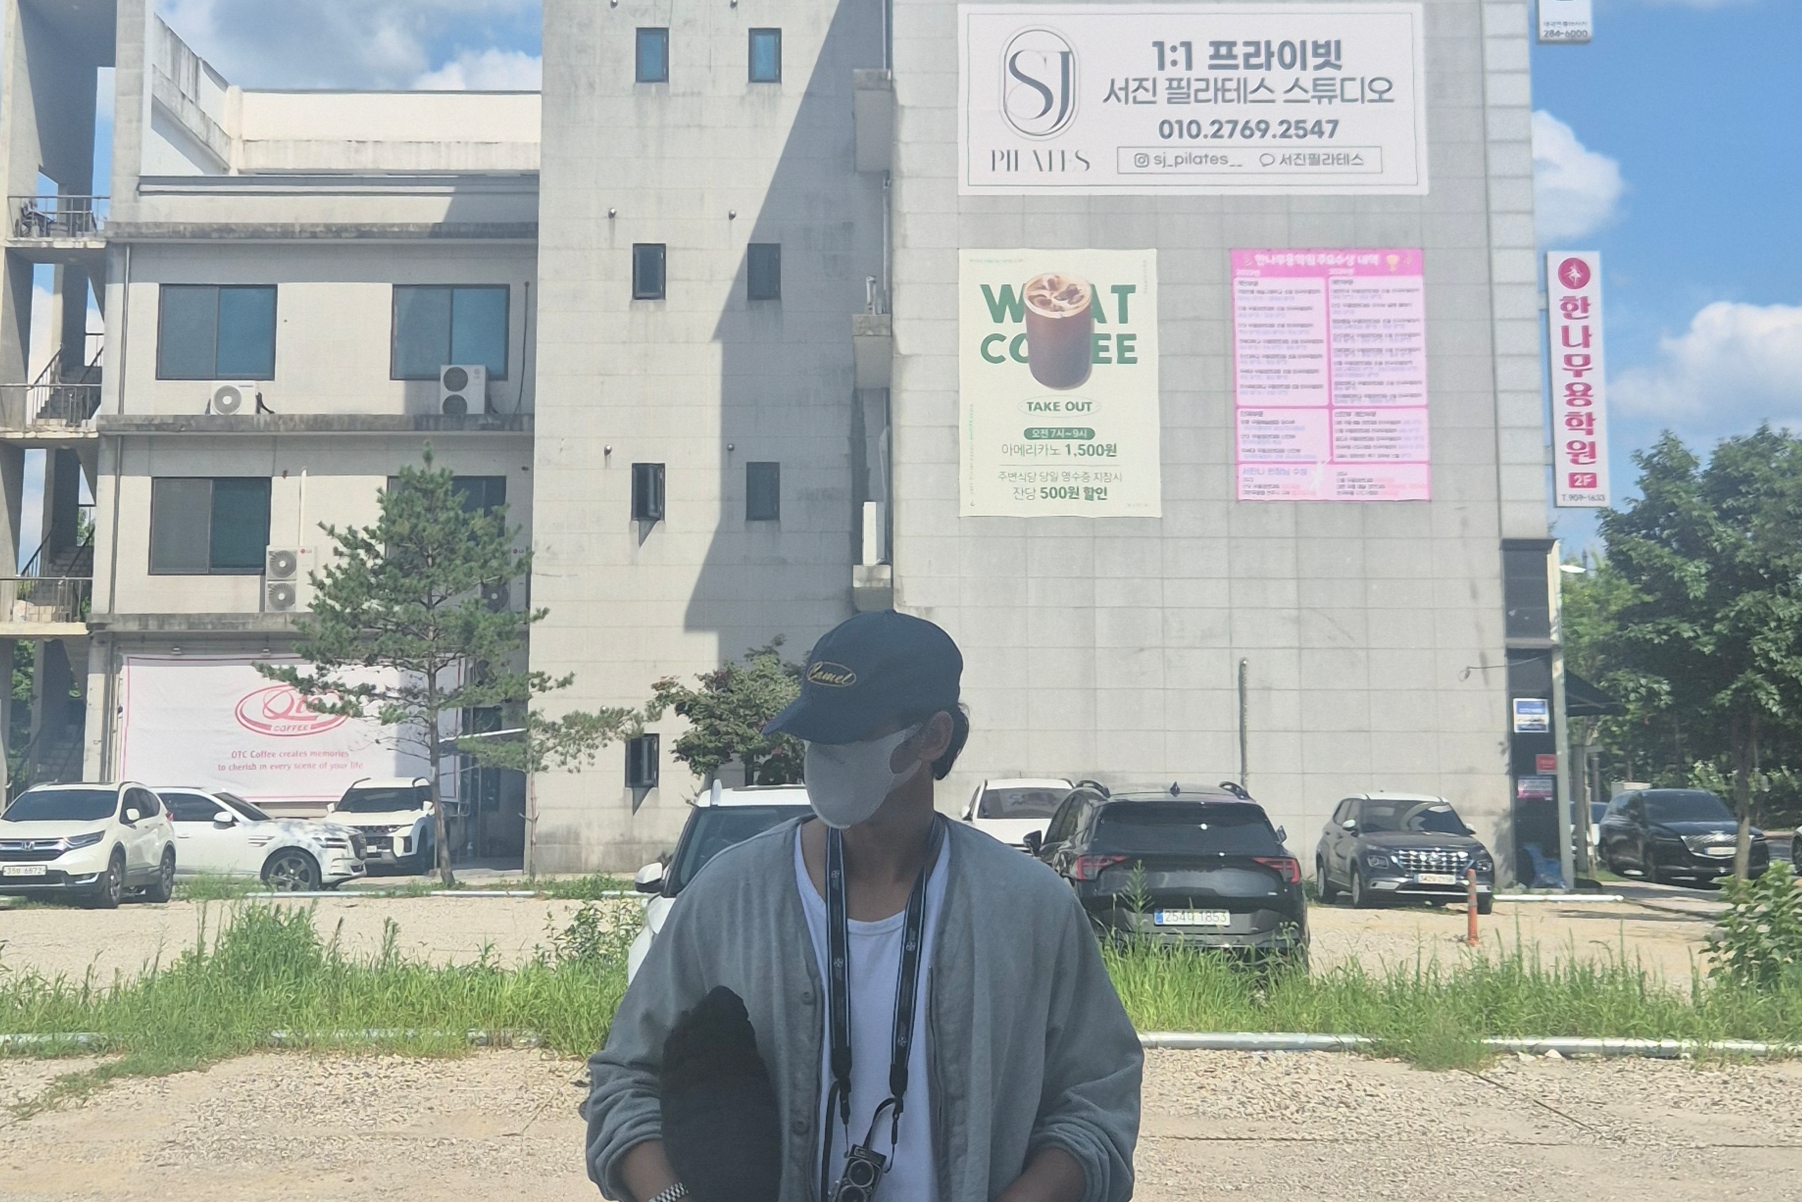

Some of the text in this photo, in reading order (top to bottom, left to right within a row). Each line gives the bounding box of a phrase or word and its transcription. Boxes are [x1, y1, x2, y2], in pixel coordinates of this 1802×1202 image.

[1151, 39, 1343, 72] 1:1 프라이빗
[1102, 77, 1395, 105] 서진 필라테스 스튜디오
[1158, 119, 1339, 140] 010.2769.2547
[1278, 153, 1365, 167] 서진필라테스
[980, 283, 1137, 324] WAT
[980, 332, 1138, 365] COEE
[1559, 295, 1597, 465] 한나무용학원
[1026, 401, 1093, 412] TAKE OUT
[1031, 428, 1049, 438] 오전
[1001, 443, 1117, 458] 아메리카노 1,500원
[998, 471, 1037, 483] 주변식당
[1039, 471, 1058, 482] 당일
[1573, 474, 1594, 486] 2F
[1013, 486, 1108, 501] 잔당 500원 할인
[273, 724, 309, 732] COFFEE
[231, 749, 350, 759] OTC Coffee creates memories
[218, 763, 226, 772] to
[228, 762, 257, 771] cherish
[269, 764, 292, 773] every
[319, 761, 328, 769] of
[329, 763, 348, 772] your
[350, 760, 363, 770] life
